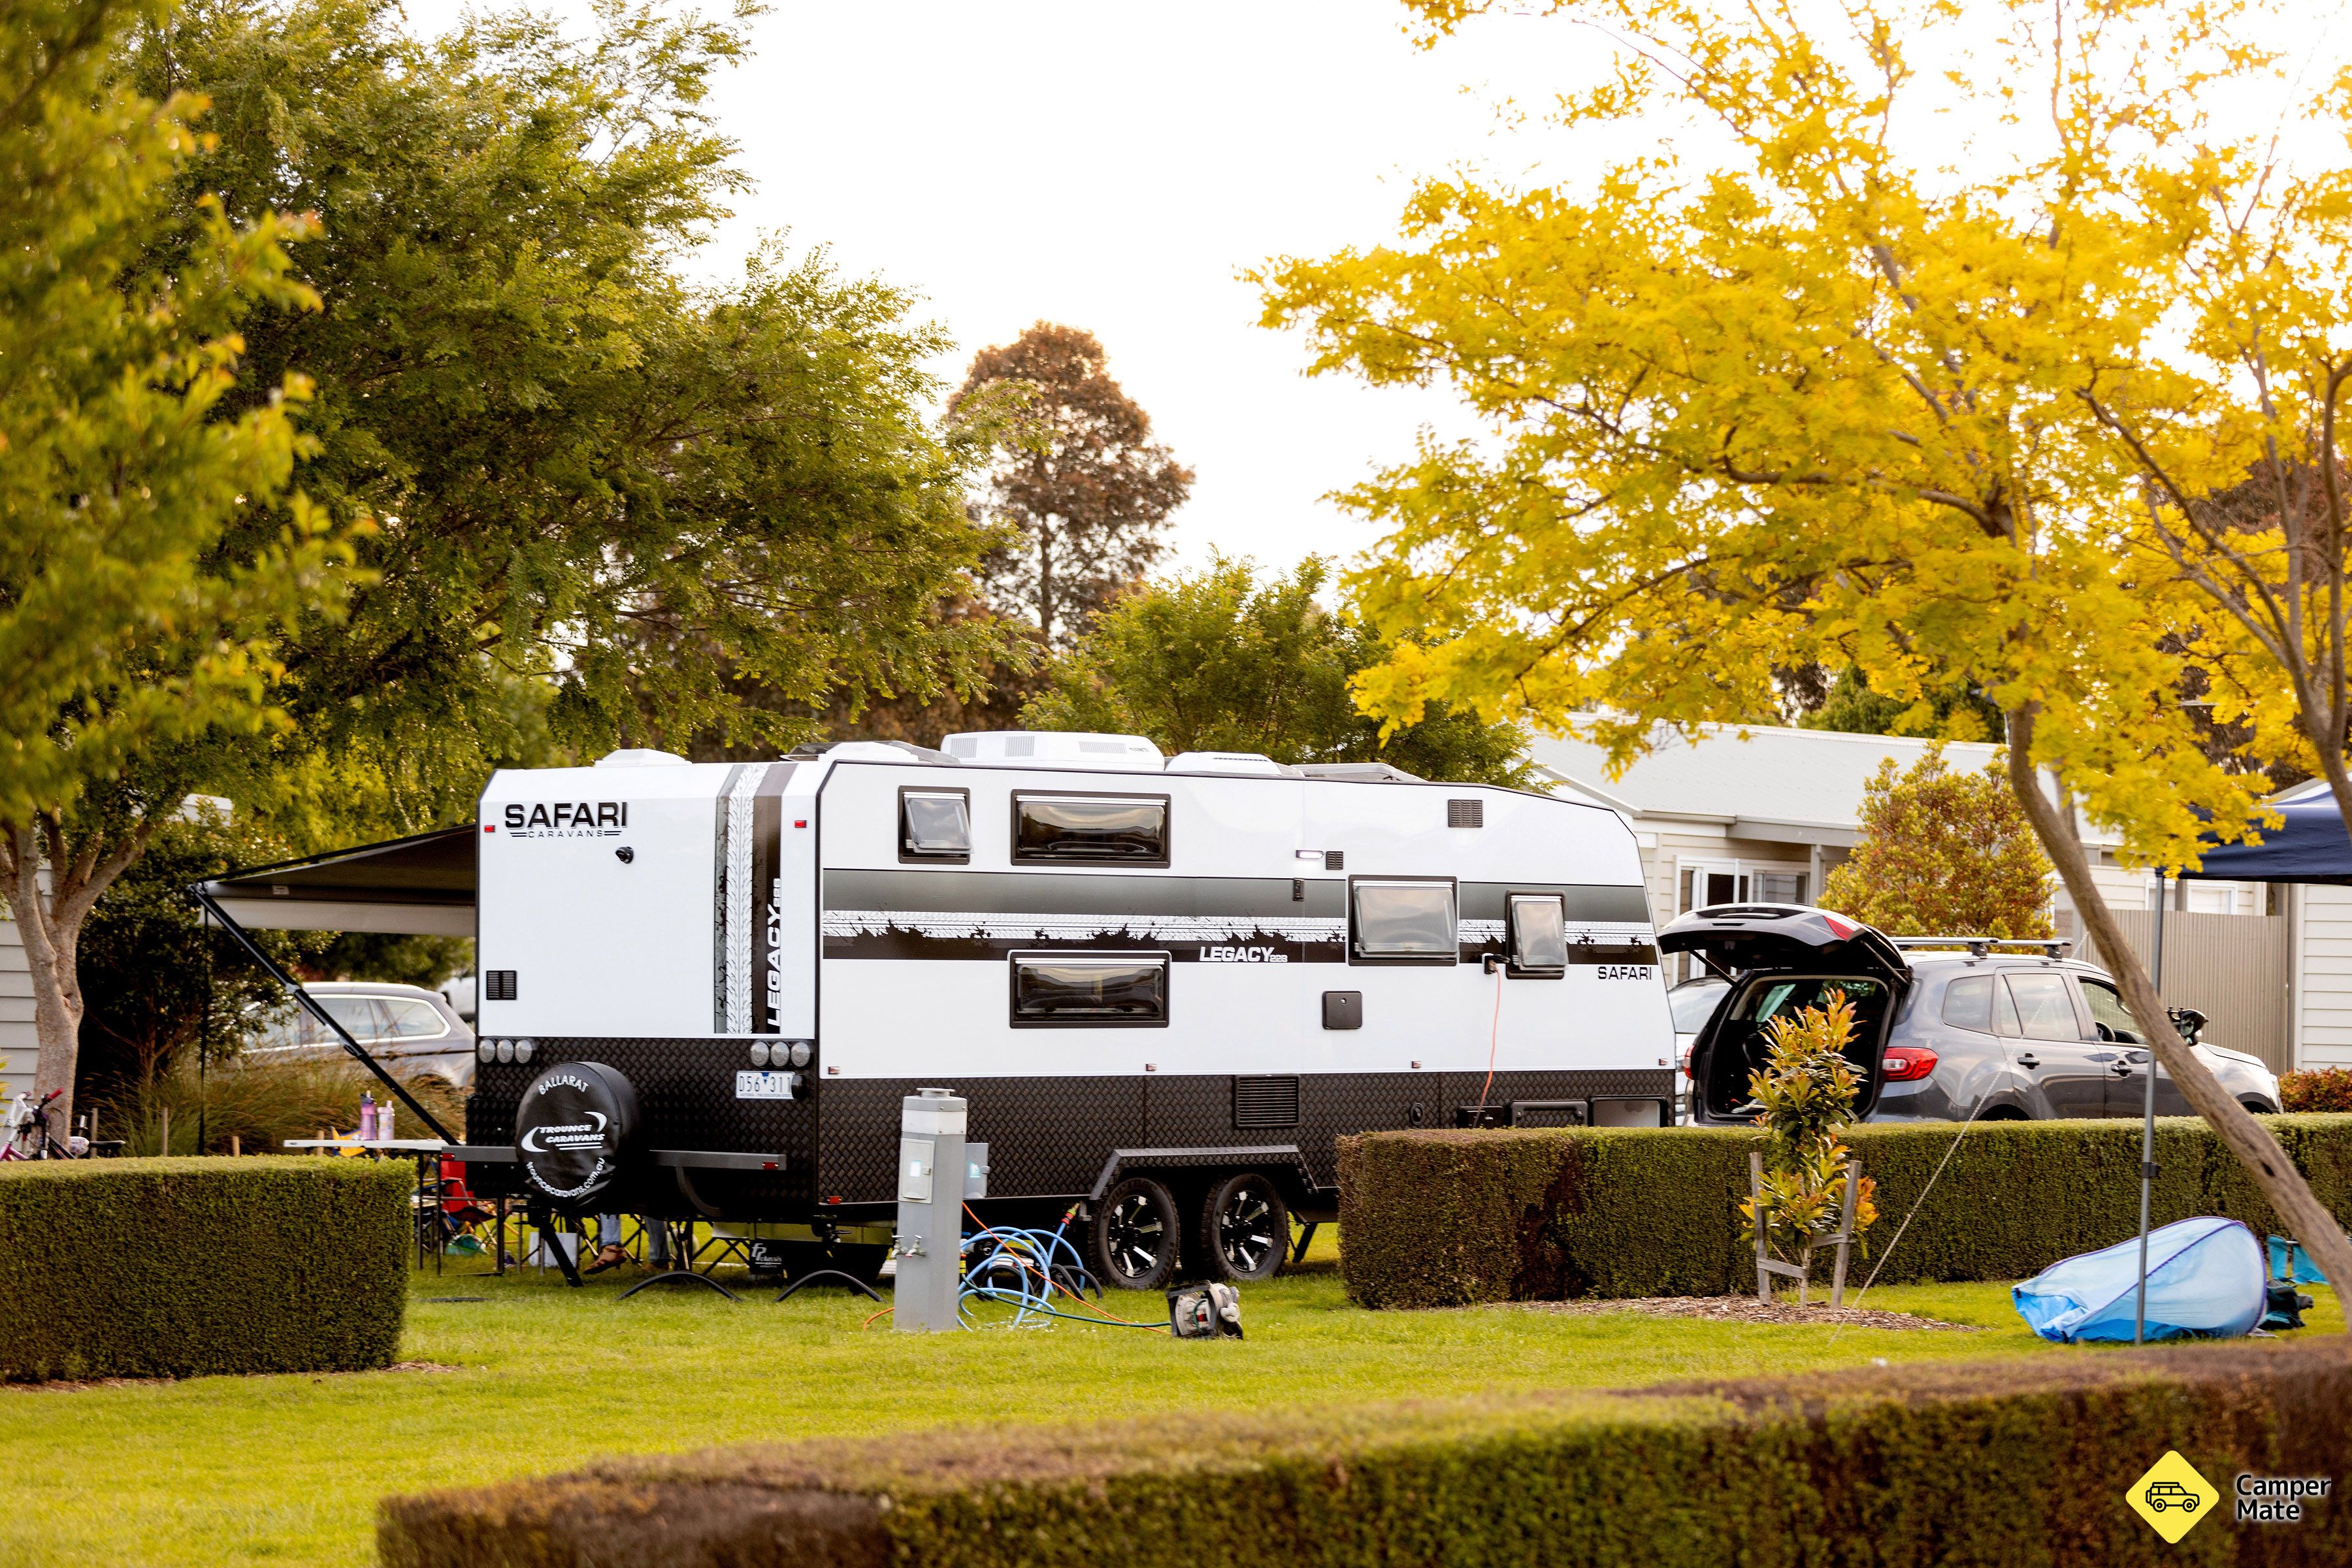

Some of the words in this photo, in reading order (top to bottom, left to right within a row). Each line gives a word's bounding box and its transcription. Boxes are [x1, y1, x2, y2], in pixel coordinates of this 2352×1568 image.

[505, 802, 628, 828] SAFARI
[1199, 946, 1275, 962] LEGACY
[767, 903, 781, 1027] LEGACY
[1598, 966, 1652, 980] SAFARI
[538, 1075, 589, 1095] BALLARAT
[739, 1075, 760, 1092] D56
[539, 1124, 593, 1134] TROUNCE
[545, 1134, 606, 1143] CARAVANS
